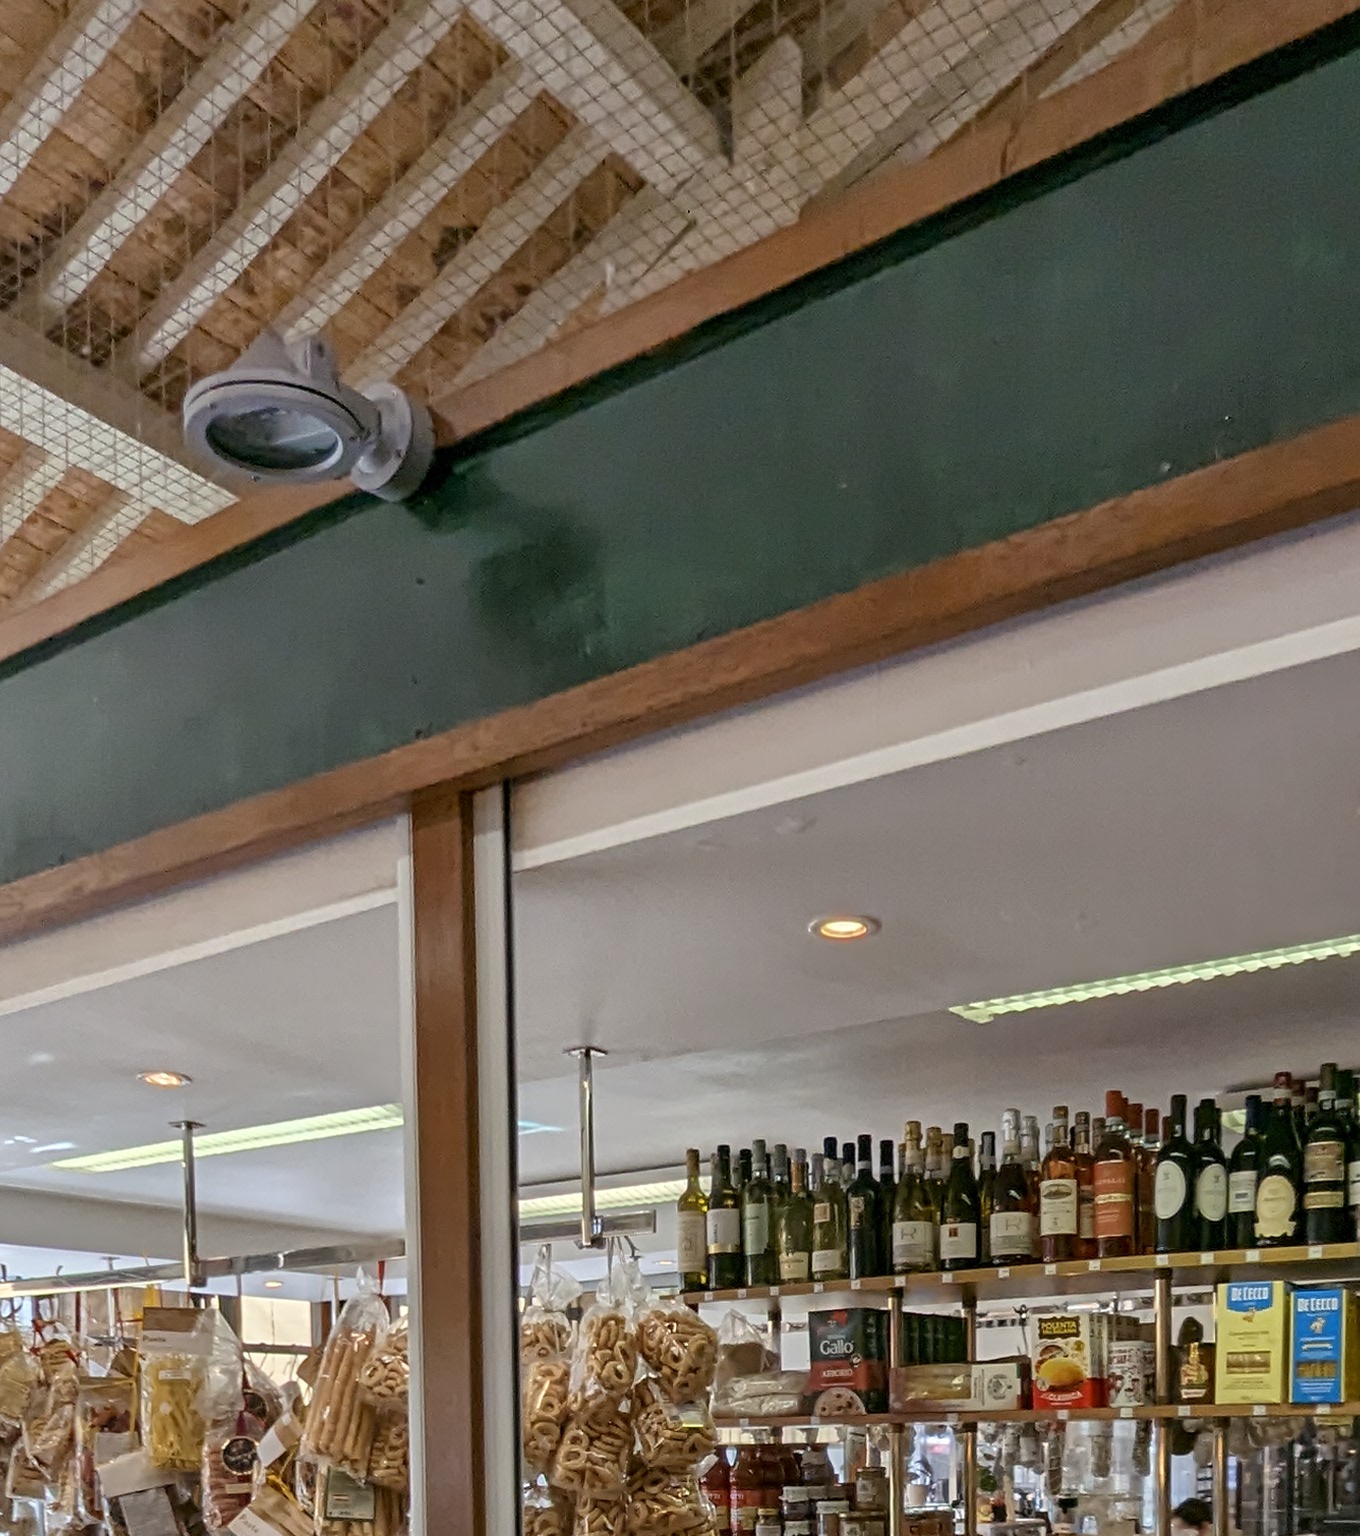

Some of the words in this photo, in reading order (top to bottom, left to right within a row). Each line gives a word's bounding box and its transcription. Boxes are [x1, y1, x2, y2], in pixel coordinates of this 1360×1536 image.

[1242, 1286, 1269, 1301] CECCO
[1310, 1297, 1339, 1312] CECCO
[1041, 1321, 1077, 1330] POLENTA
[819, 1340, 854, 1355] Gallo
